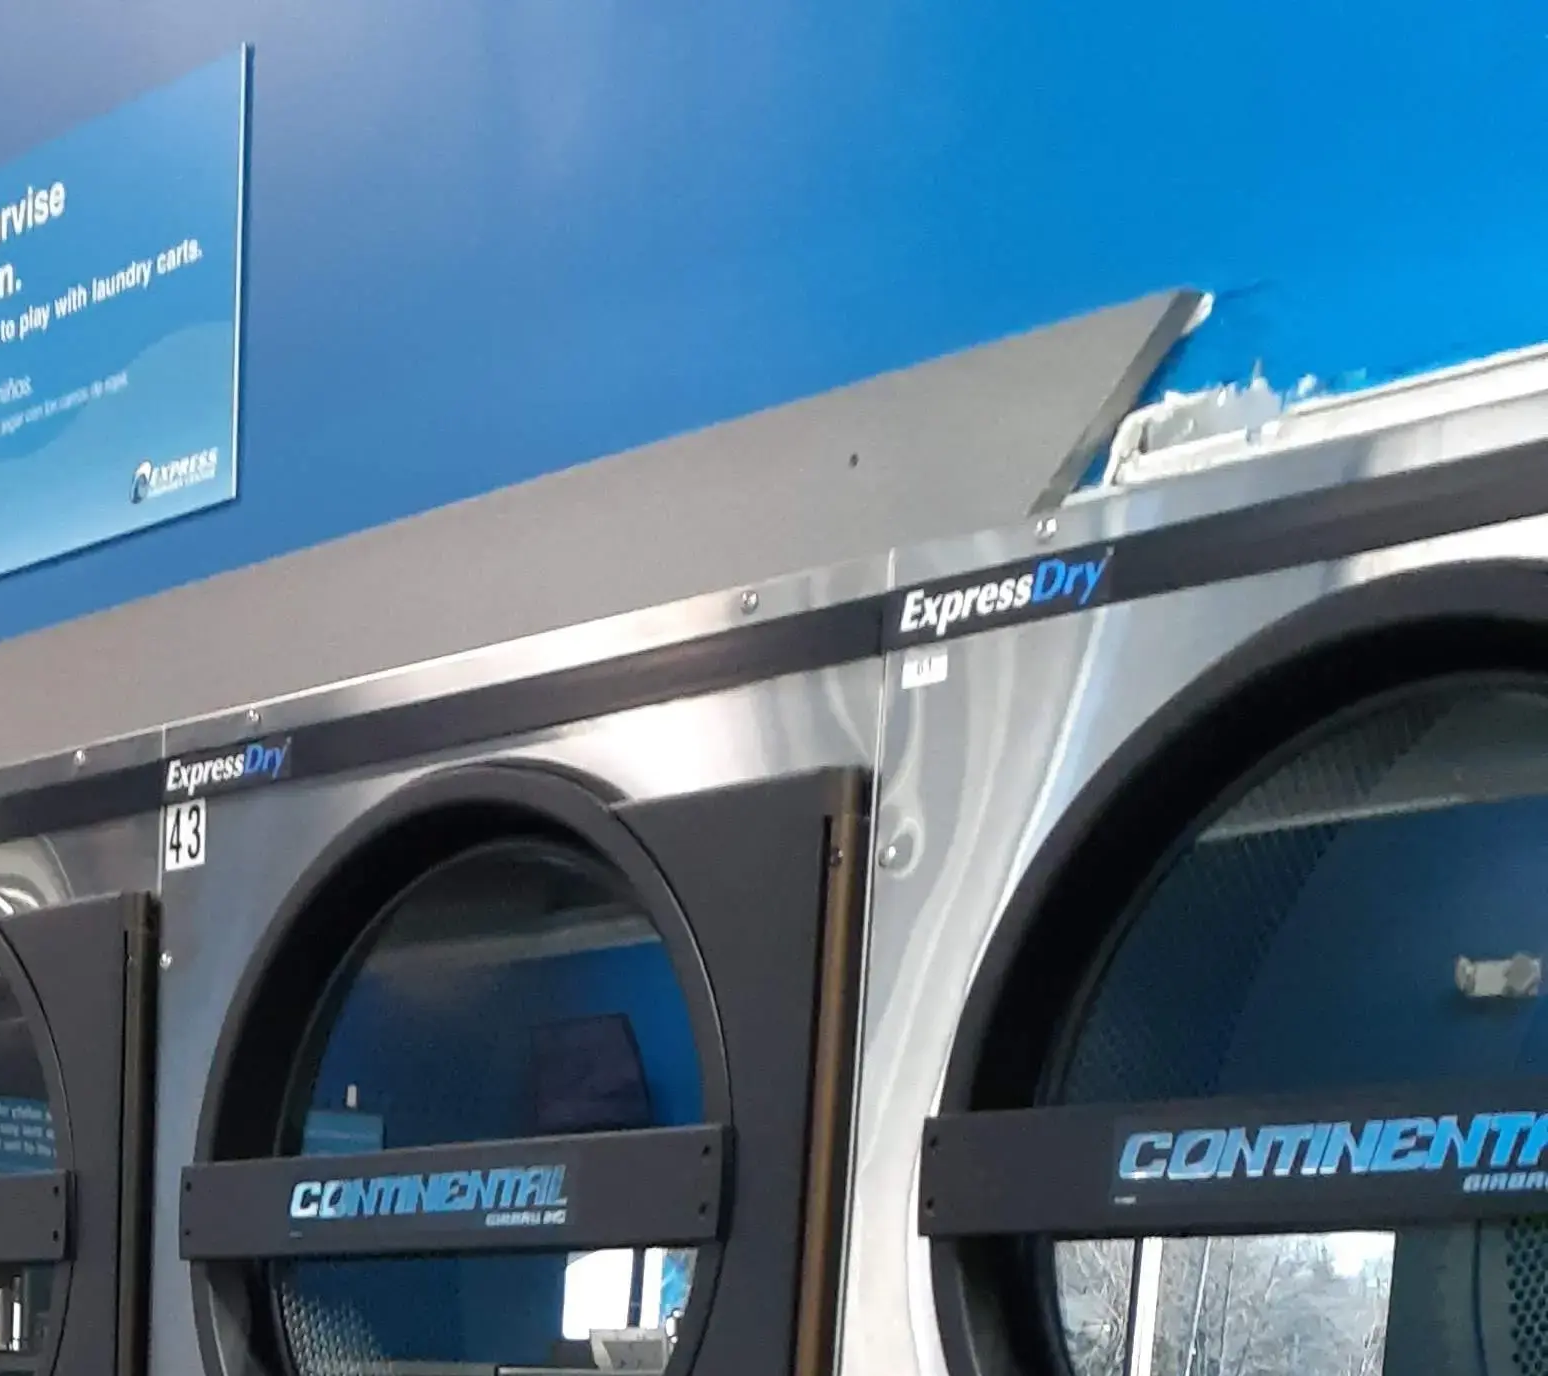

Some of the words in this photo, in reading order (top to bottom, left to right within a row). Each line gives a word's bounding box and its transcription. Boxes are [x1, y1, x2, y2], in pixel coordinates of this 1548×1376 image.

[0, 319, 15, 342] to
[20, 303, 51, 341] play
[54, 283, 88, 319] with
[92, 259, 152, 303] laundry
[156, 238, 203, 274] carts.
[899, 556, 1110, 637] ExpressDry
[166, 741, 290, 796] ExpressDry
[169, 804, 201, 864] 43
[290, 1164, 567, 1219] CONTINENTAL
